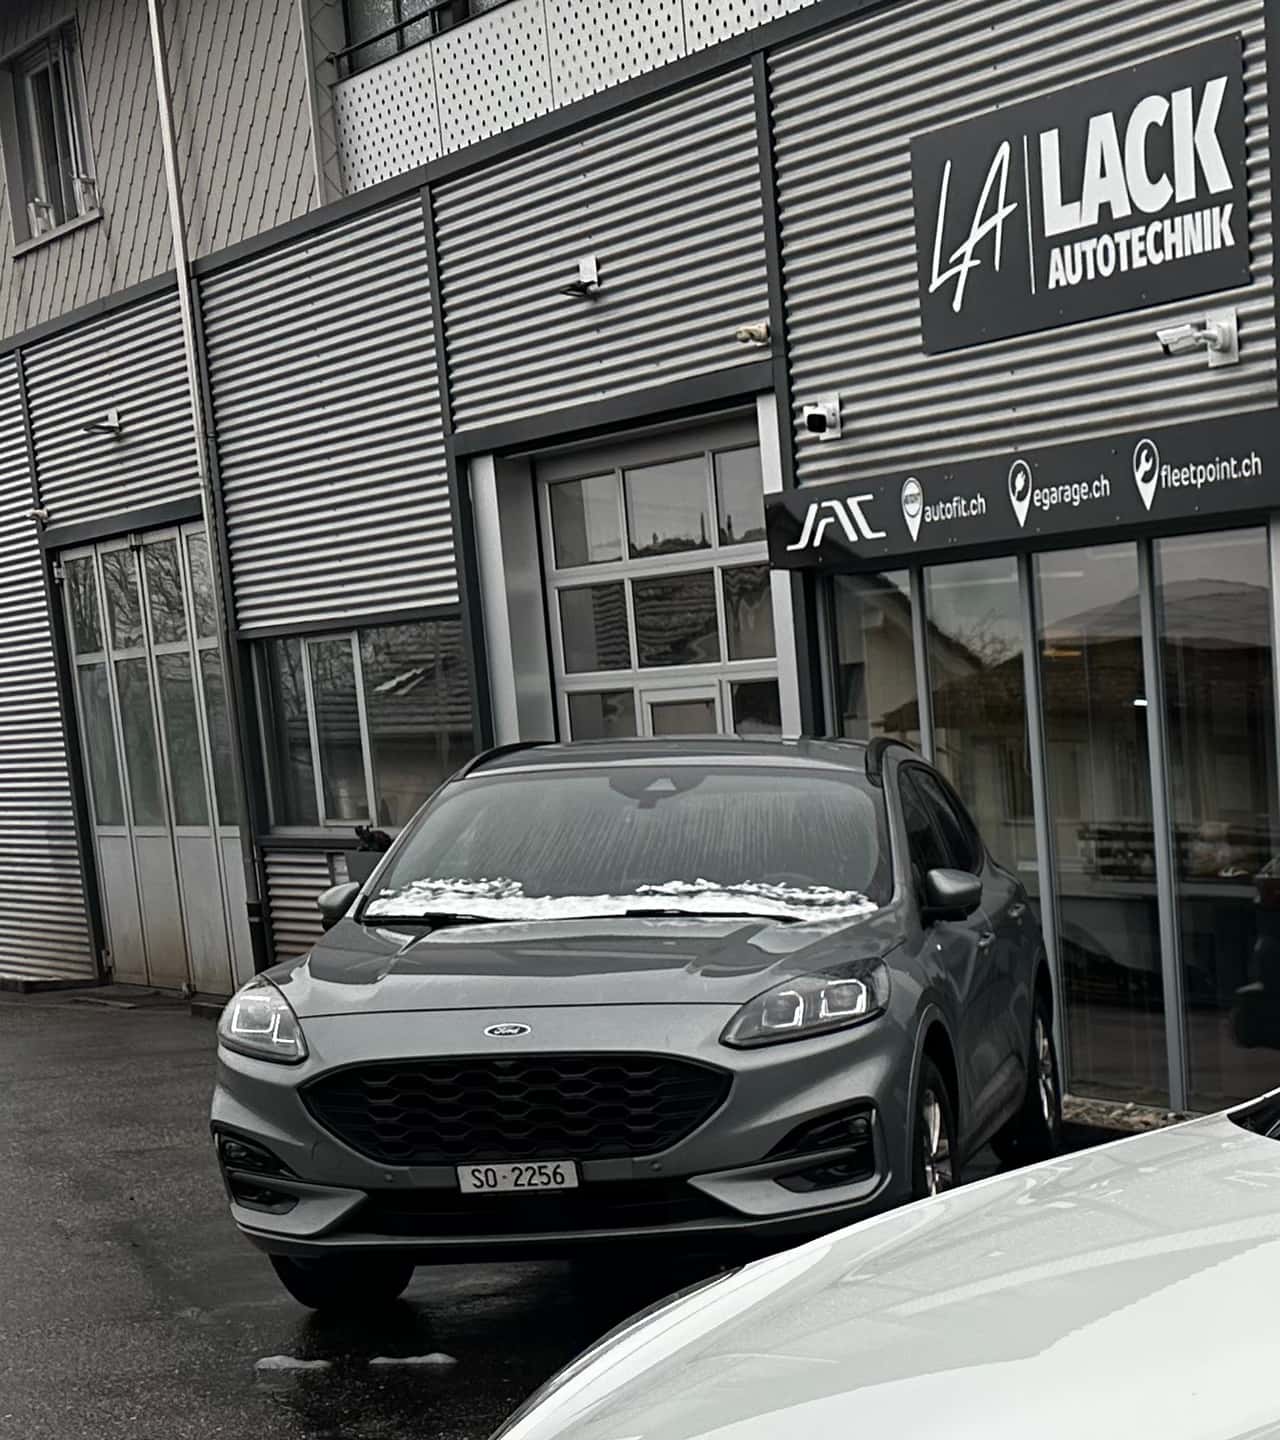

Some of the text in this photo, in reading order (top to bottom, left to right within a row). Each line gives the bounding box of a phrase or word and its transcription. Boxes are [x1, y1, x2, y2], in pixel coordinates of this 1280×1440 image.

[1040, 76, 1234, 238] LACK
[1048, 203, 1235, 290] AUTOTECHNIK
[1160, 451, 1263, 489] fleetpoint.ch
[923, 492, 986, 524] autofit.ch
[1033, 474, 1111, 511] egarage.ch
[471, 1164, 566, 1189] SO 2256
